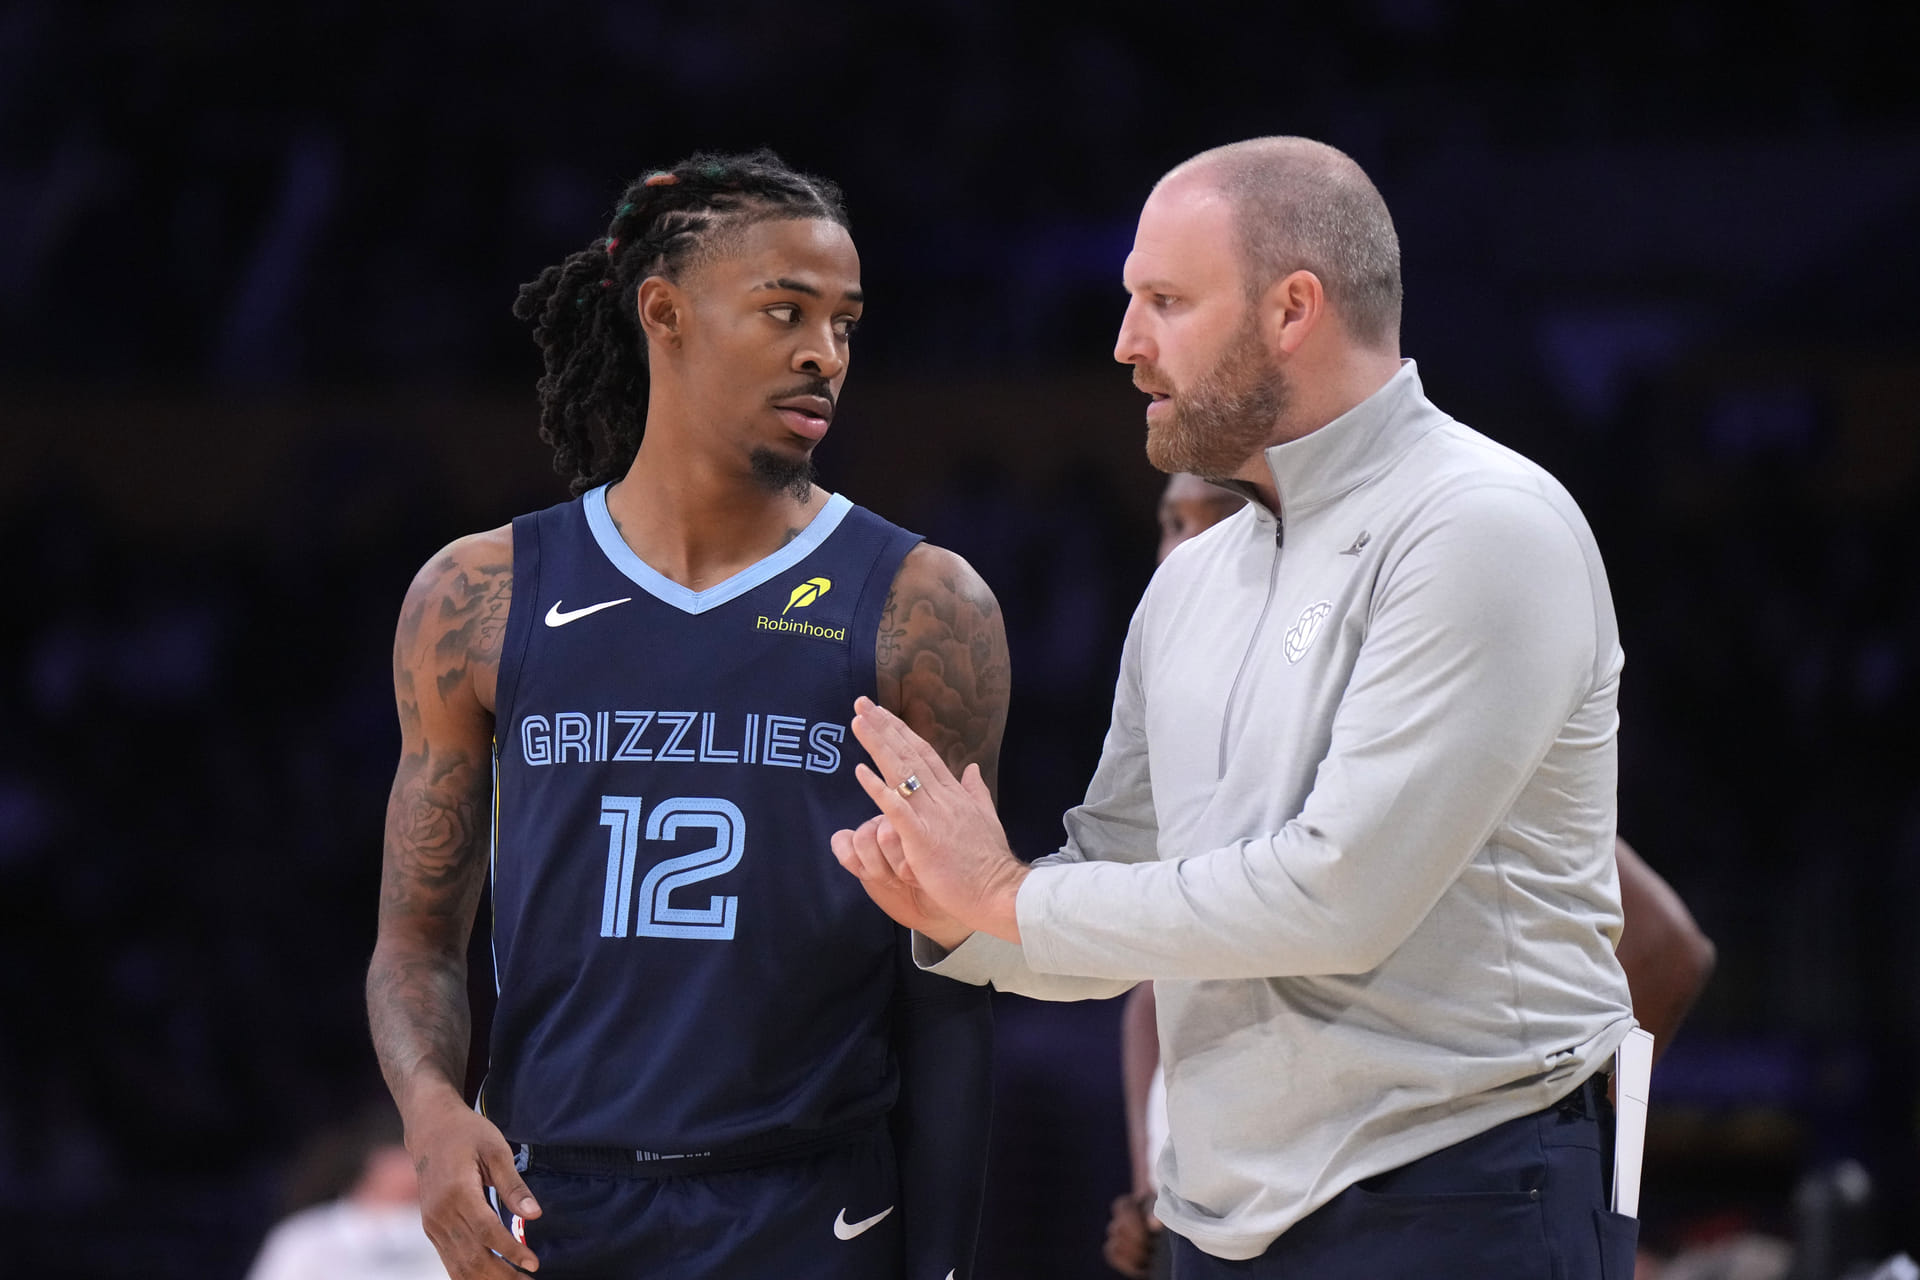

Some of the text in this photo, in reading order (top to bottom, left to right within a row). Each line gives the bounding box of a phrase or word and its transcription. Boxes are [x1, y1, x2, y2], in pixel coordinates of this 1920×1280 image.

[756, 616, 845, 641] Robinhood
[521, 710, 846, 774] GRIZZLIES
[600, 795, 746, 940] 12
